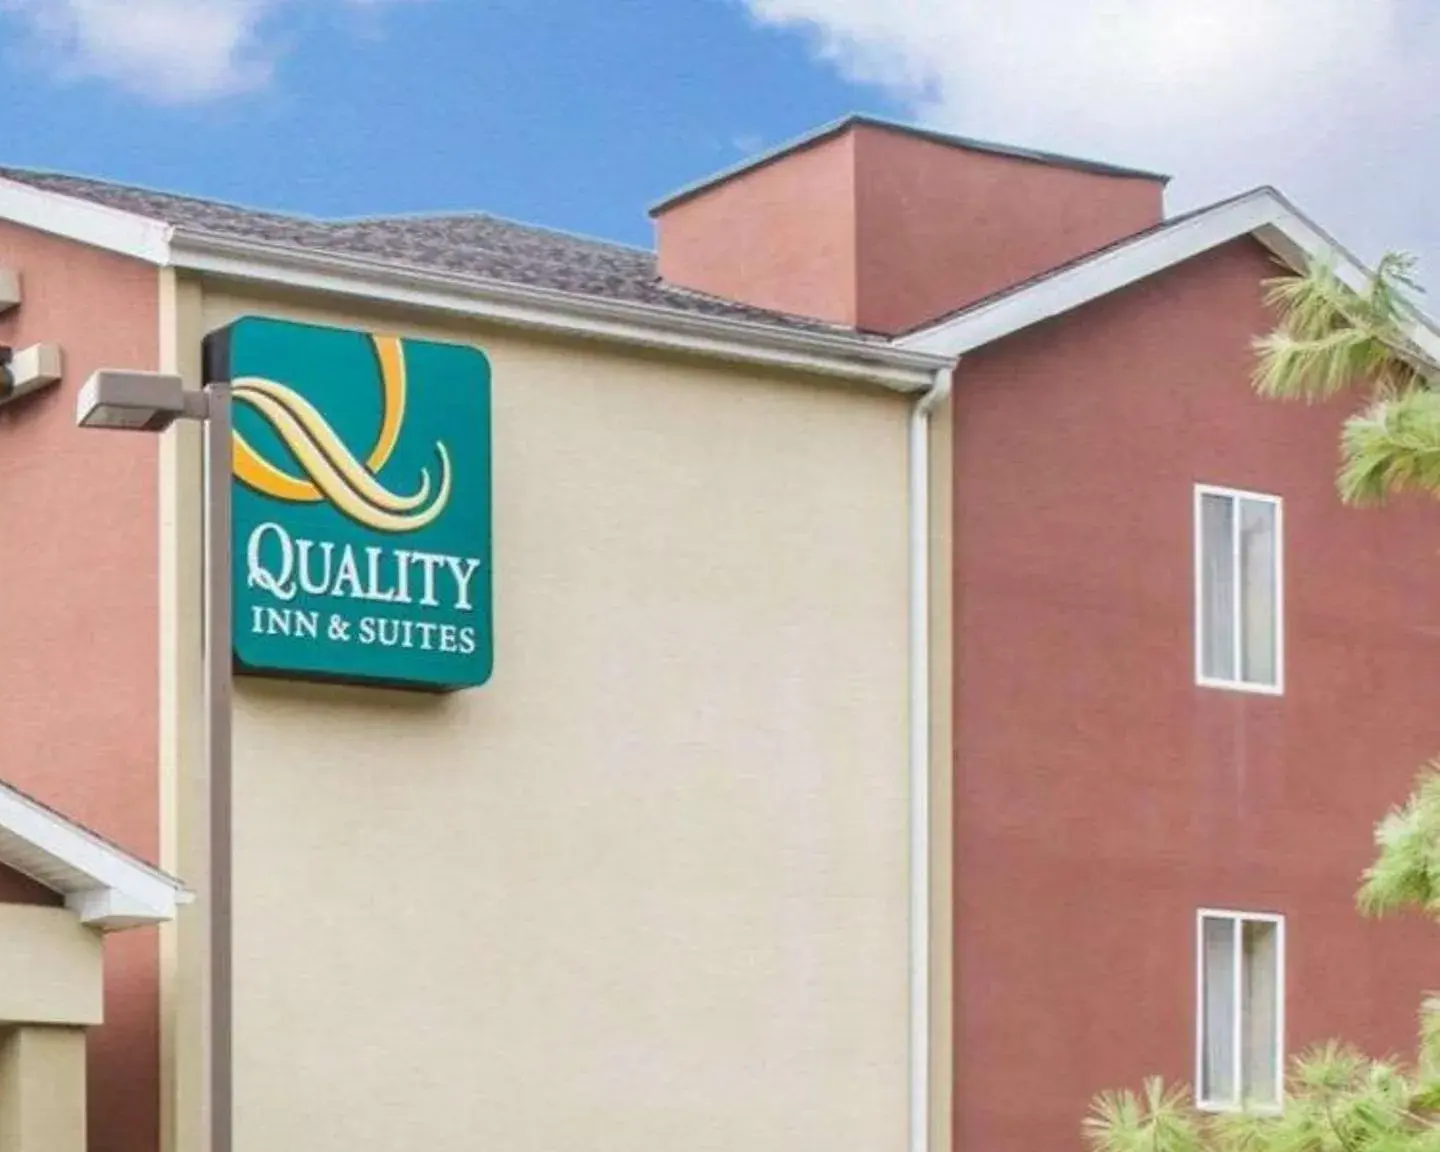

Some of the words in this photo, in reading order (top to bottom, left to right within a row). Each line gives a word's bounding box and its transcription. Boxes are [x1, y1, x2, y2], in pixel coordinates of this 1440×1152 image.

[246, 521, 480, 611] QUALITY
[251, 605, 319, 639] INN
[327, 613, 351, 642] &
[359, 616, 476, 654] SUITES
